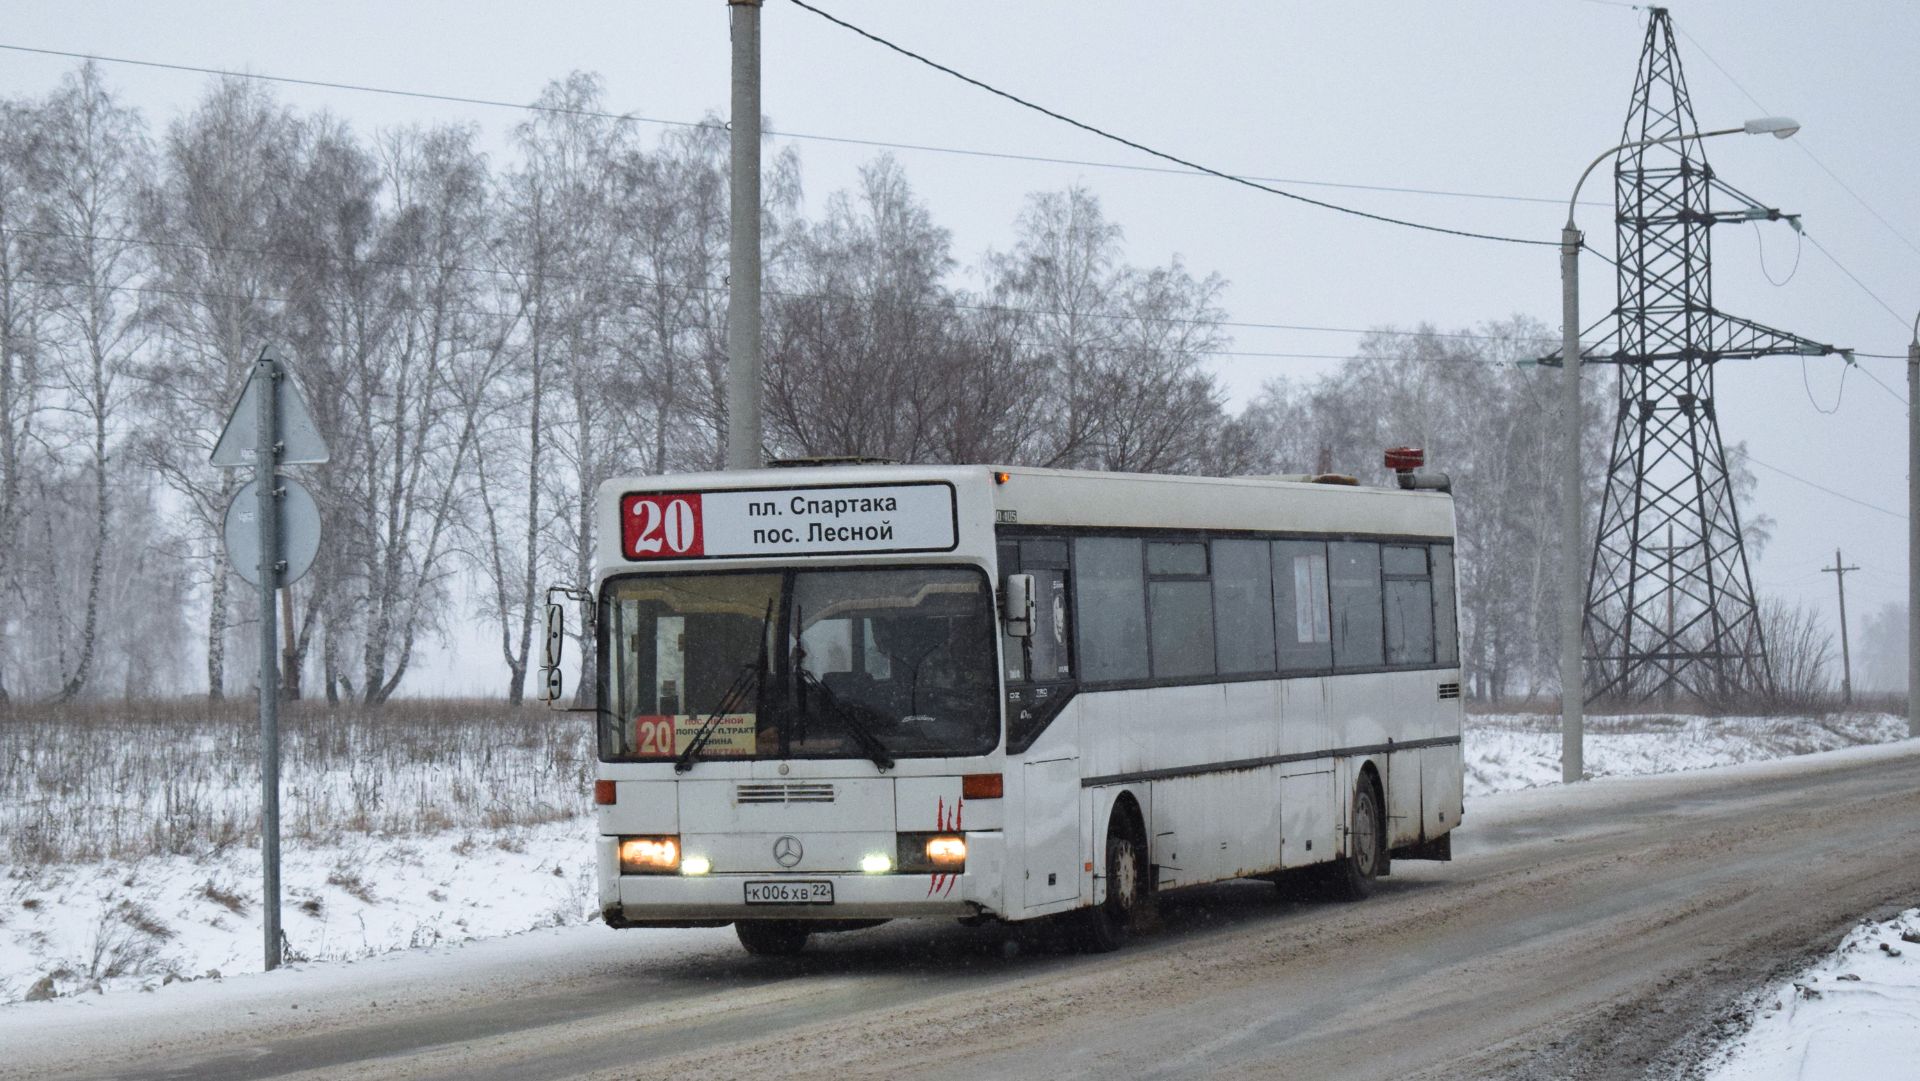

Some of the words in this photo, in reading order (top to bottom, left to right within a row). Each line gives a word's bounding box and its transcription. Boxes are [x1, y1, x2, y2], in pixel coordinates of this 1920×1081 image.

[748, 502, 782, 516] пл.
[789, 496, 897, 517] Спартака
[632, 499, 695, 553] 20
[752, 523, 799, 544] пос.
[807, 520, 893, 542] Лесной
[640, 720, 672, 753] 20
[752, 885, 808, 900] К006ХВ
[812, 884, 827, 896] 22
